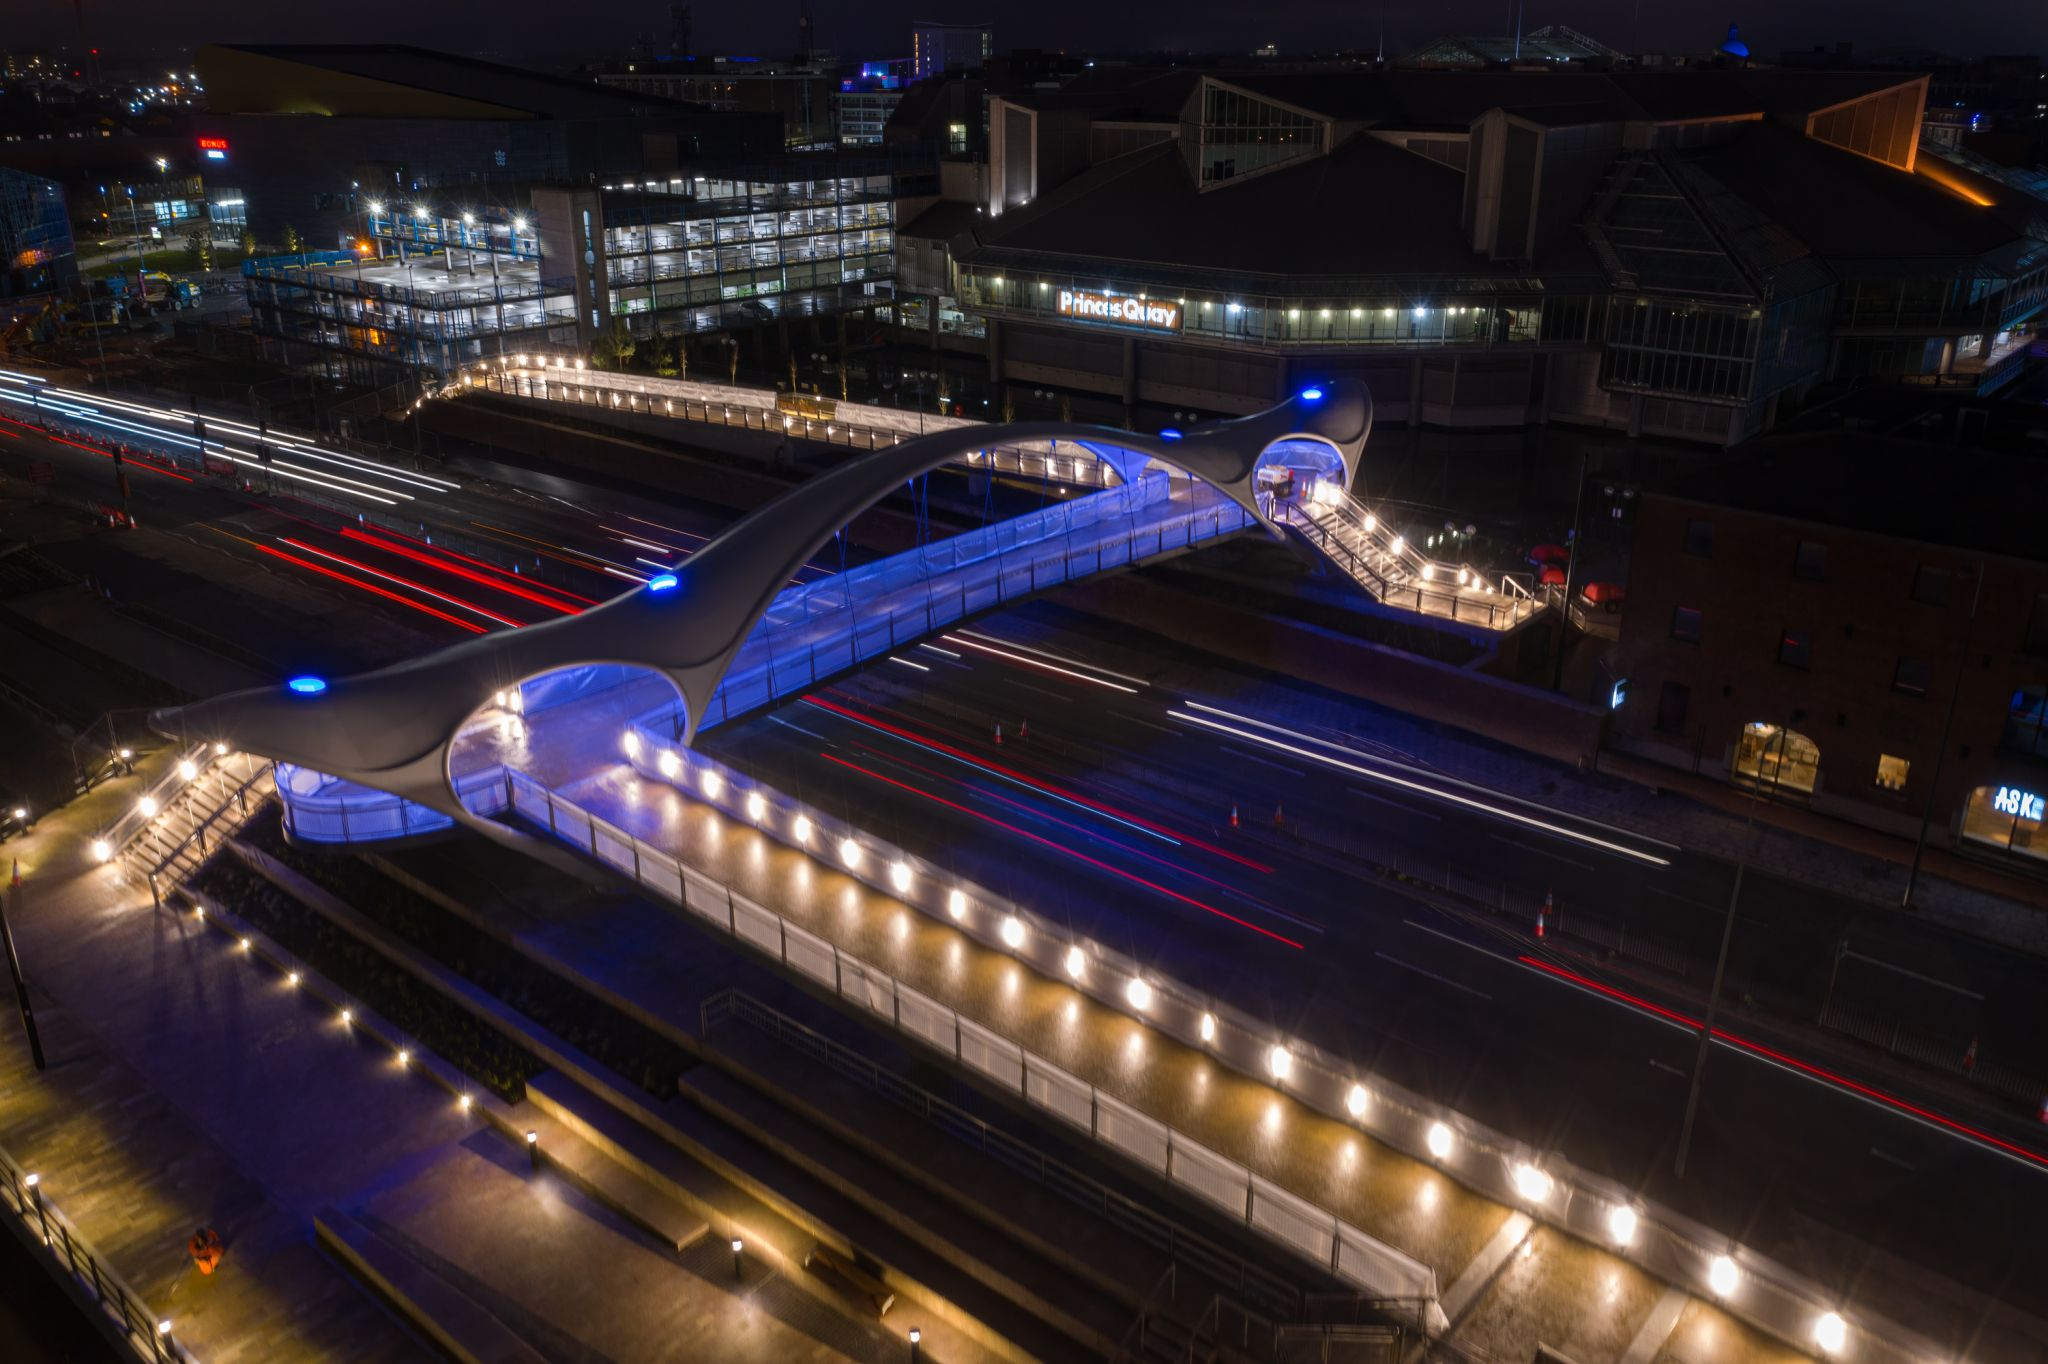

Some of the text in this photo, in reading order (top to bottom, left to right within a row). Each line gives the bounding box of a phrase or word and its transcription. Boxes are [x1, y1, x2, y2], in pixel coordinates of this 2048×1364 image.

[202, 140, 226, 148] BONUS
[1061, 291, 1176, 327] Princes Quay
[1994, 786, 2035, 818] ASK
